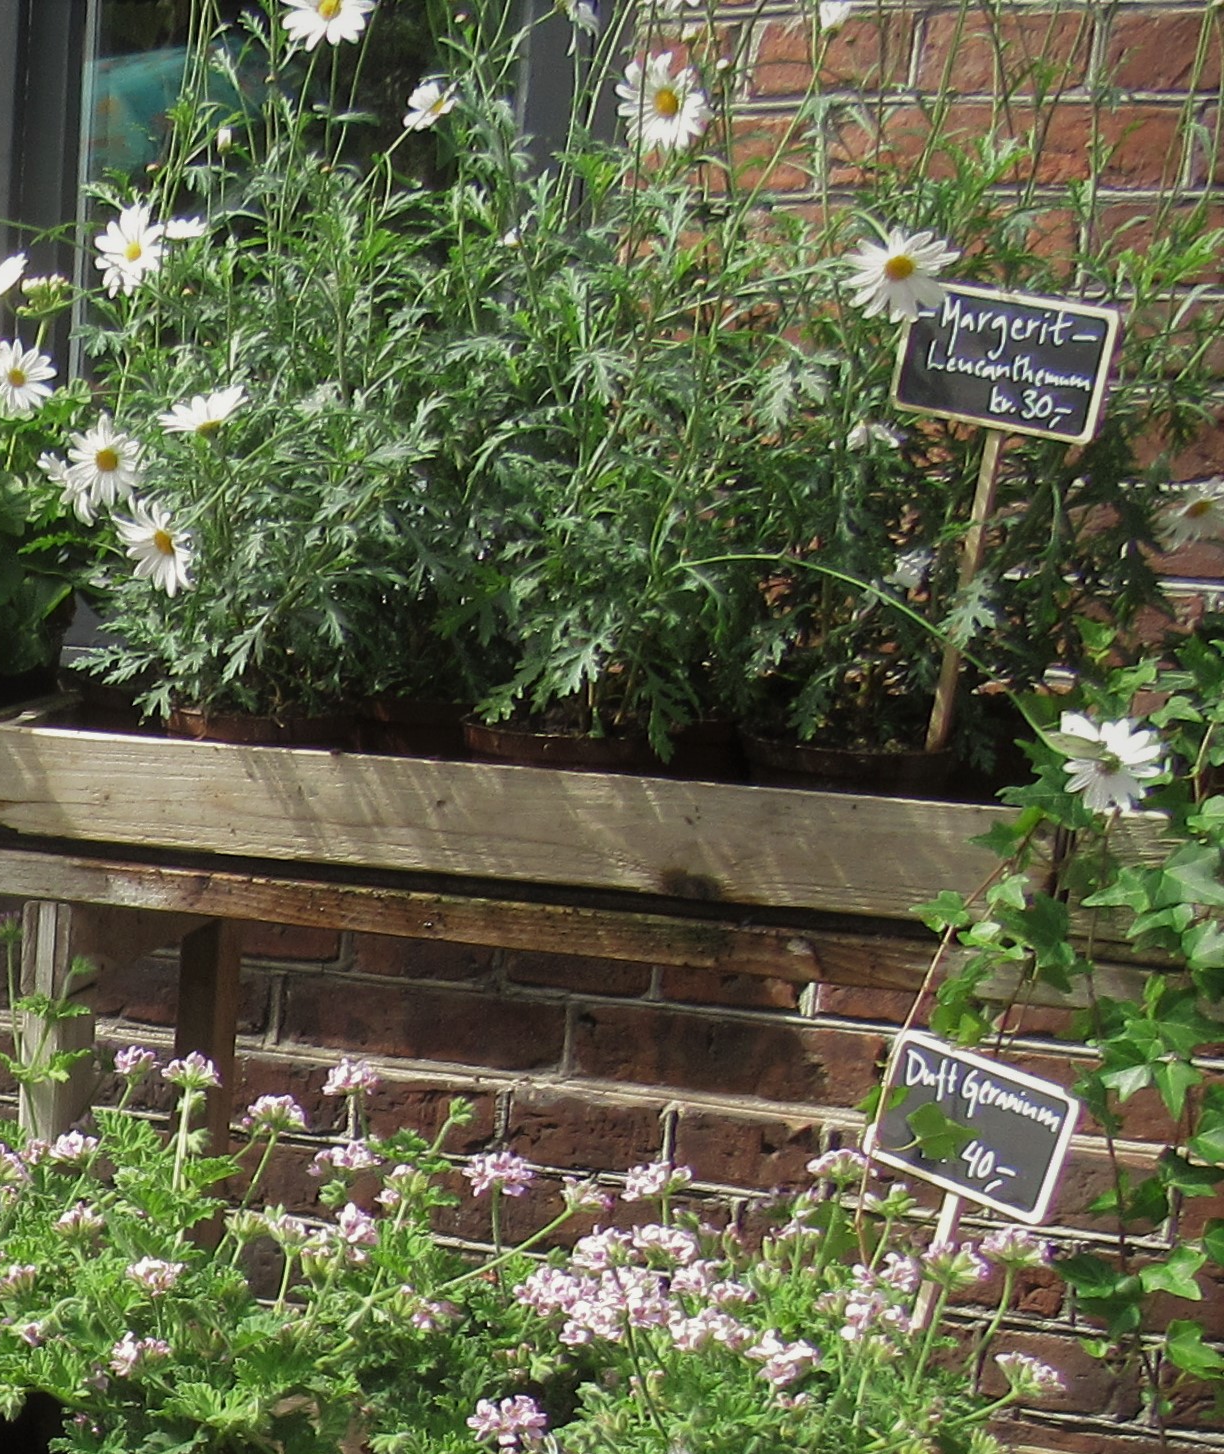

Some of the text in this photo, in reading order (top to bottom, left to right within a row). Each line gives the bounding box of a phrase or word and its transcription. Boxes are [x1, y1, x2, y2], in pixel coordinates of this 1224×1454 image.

[927, 339, 1091, 391] Leucanthemum
[989, 386, 1016, 414] kr.
[906, 1049, 1061, 1133] Duft Geranium
